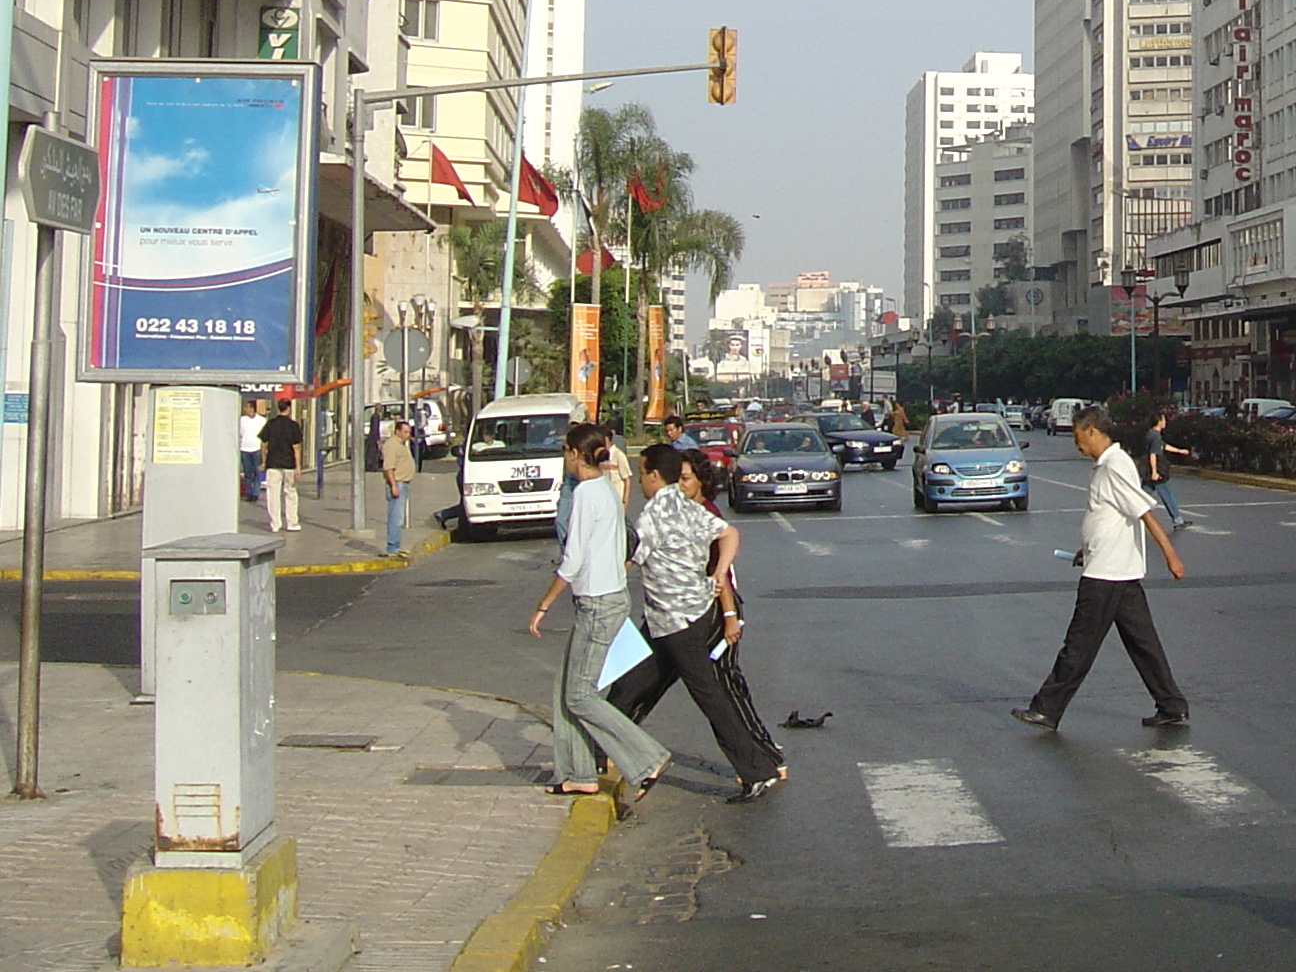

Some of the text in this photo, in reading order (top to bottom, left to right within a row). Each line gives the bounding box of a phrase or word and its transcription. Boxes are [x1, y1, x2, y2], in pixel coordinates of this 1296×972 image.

[1233, 27, 1252, 81] air
[1233, 97, 1252, 182] maroc
[140, 238, 159, 246] pour
[160, 237, 186, 246] mieux
[136, 318, 256, 335] 022 43 18 18
